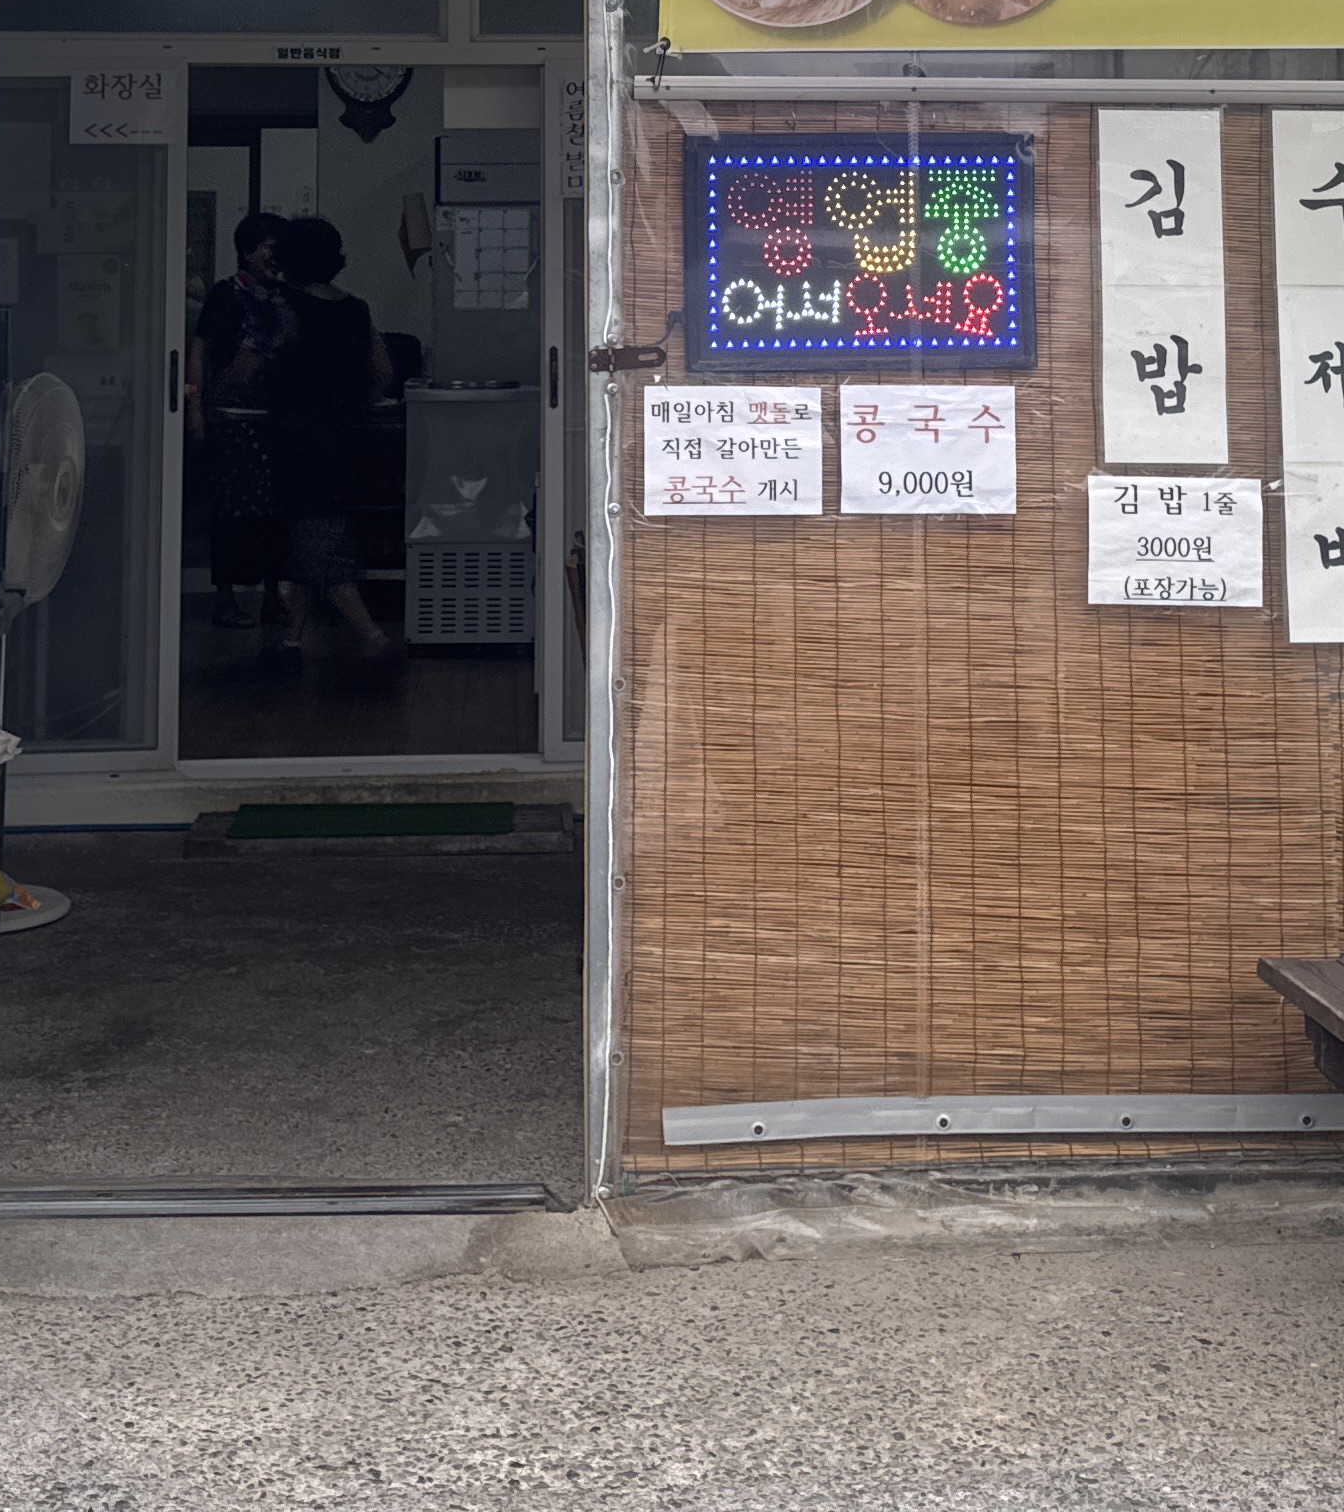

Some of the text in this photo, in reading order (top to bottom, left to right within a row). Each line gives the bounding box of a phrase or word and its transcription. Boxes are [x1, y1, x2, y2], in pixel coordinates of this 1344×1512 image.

[277, 47, 340, 59] 일반음식점
[82, 73, 163, 101] 화장실
[727, 169, 1000, 276] 영업중
[1124, 159, 1202, 416] 김밥
[721, 272, 1004, 337] 어서오세요
[651, 400, 813, 424] 매일아침 맷돌로
[661, 437, 802, 461] 직접 갈아만든
[663, 475, 799, 504] 콩국수 개시
[877, 469, 975, 498] 9,000원
[1202, 491, 1238, 516] 1줄
[1136, 536, 1214, 562] 3000원
[1124, 576, 1227, 602] (포장가능)
